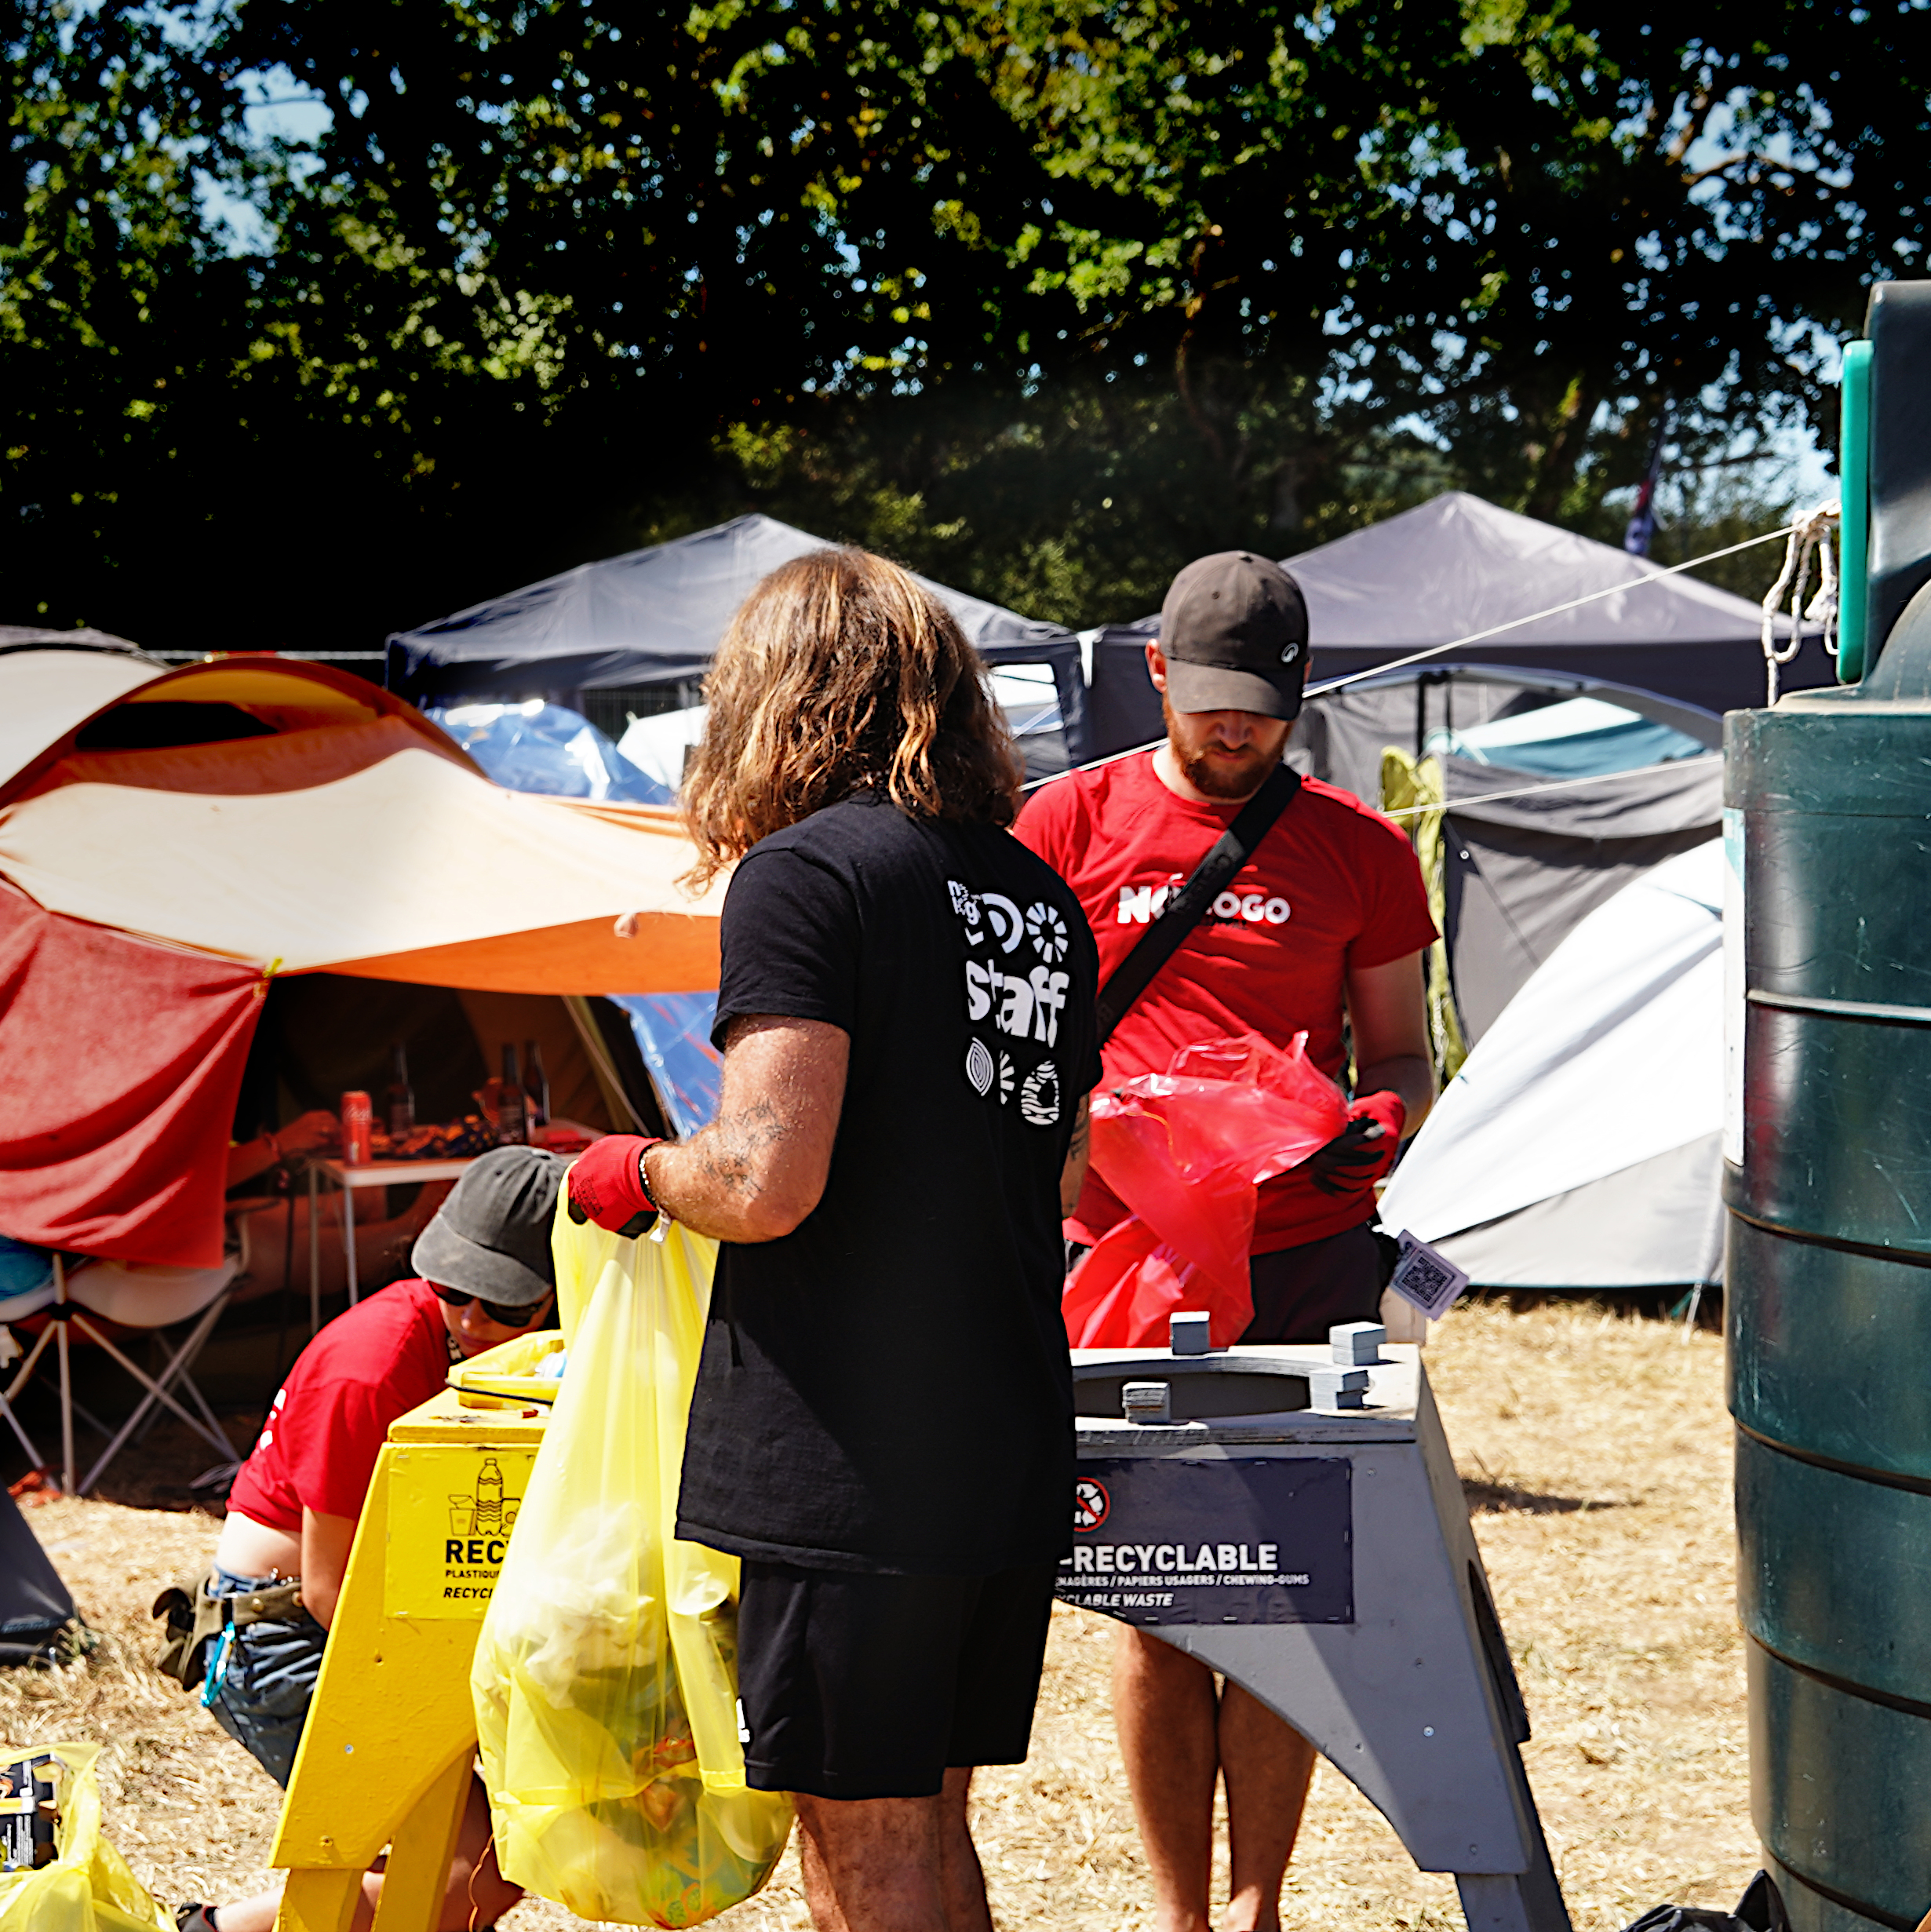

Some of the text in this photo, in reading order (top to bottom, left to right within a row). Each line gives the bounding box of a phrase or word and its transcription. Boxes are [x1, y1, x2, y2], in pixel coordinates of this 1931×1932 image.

[1205, 891, 1292, 924] OGO
[446, 1540, 509, 1564] REC
[1055, 1573, 1109, 1588] NAGÈRES
[1117, 1575, 1164, 1587] PAPIERS
[1223, 1573, 1310, 1585] CHEWING-GUMS
[1122, 1592, 1175, 1607] WASTE
